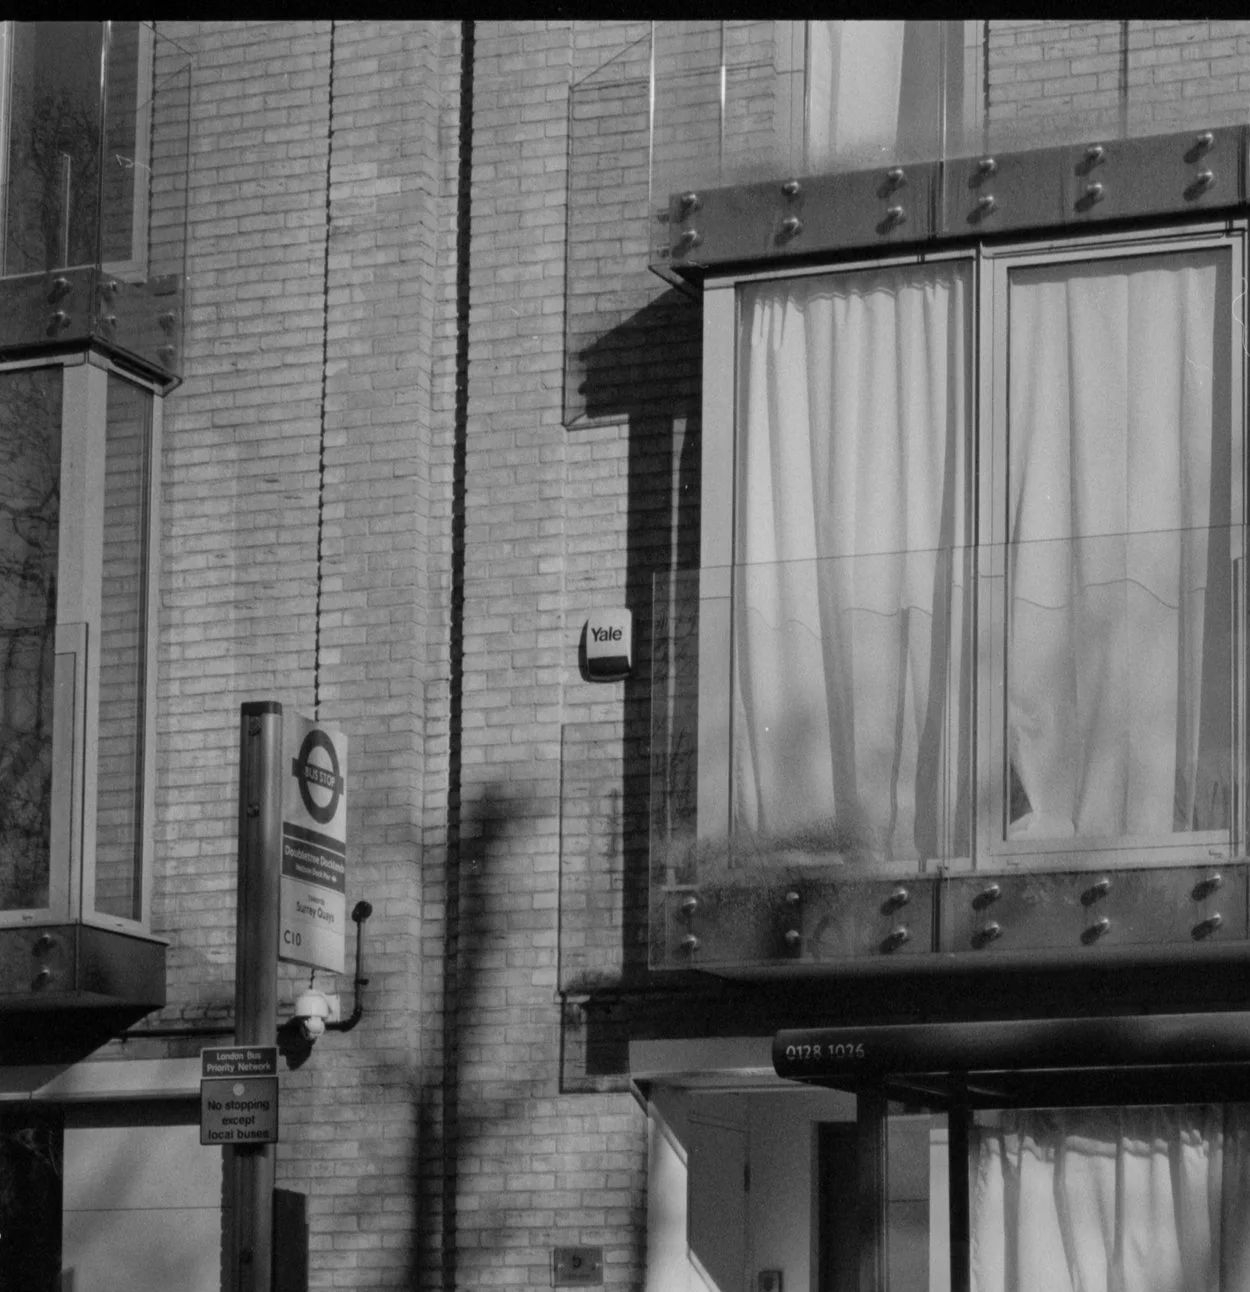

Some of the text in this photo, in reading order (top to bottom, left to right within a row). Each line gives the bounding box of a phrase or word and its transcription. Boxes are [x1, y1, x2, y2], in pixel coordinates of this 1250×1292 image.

[591, 626, 623, 642] Yale
[304, 766, 336, 787] BUS STOP
[296, 901, 335, 924] Surrey Quays
[283, 929, 302, 946] C10
[216, 1051, 261, 1061] London Bus
[785, 1043, 865, 1060] 0128 1026
[206, 1062, 271, 1073] Priority Network
[207, 1100, 269, 1111] No stopping
[221, 1115, 255, 1126] except
[208, 1129, 269, 1140] local buses
